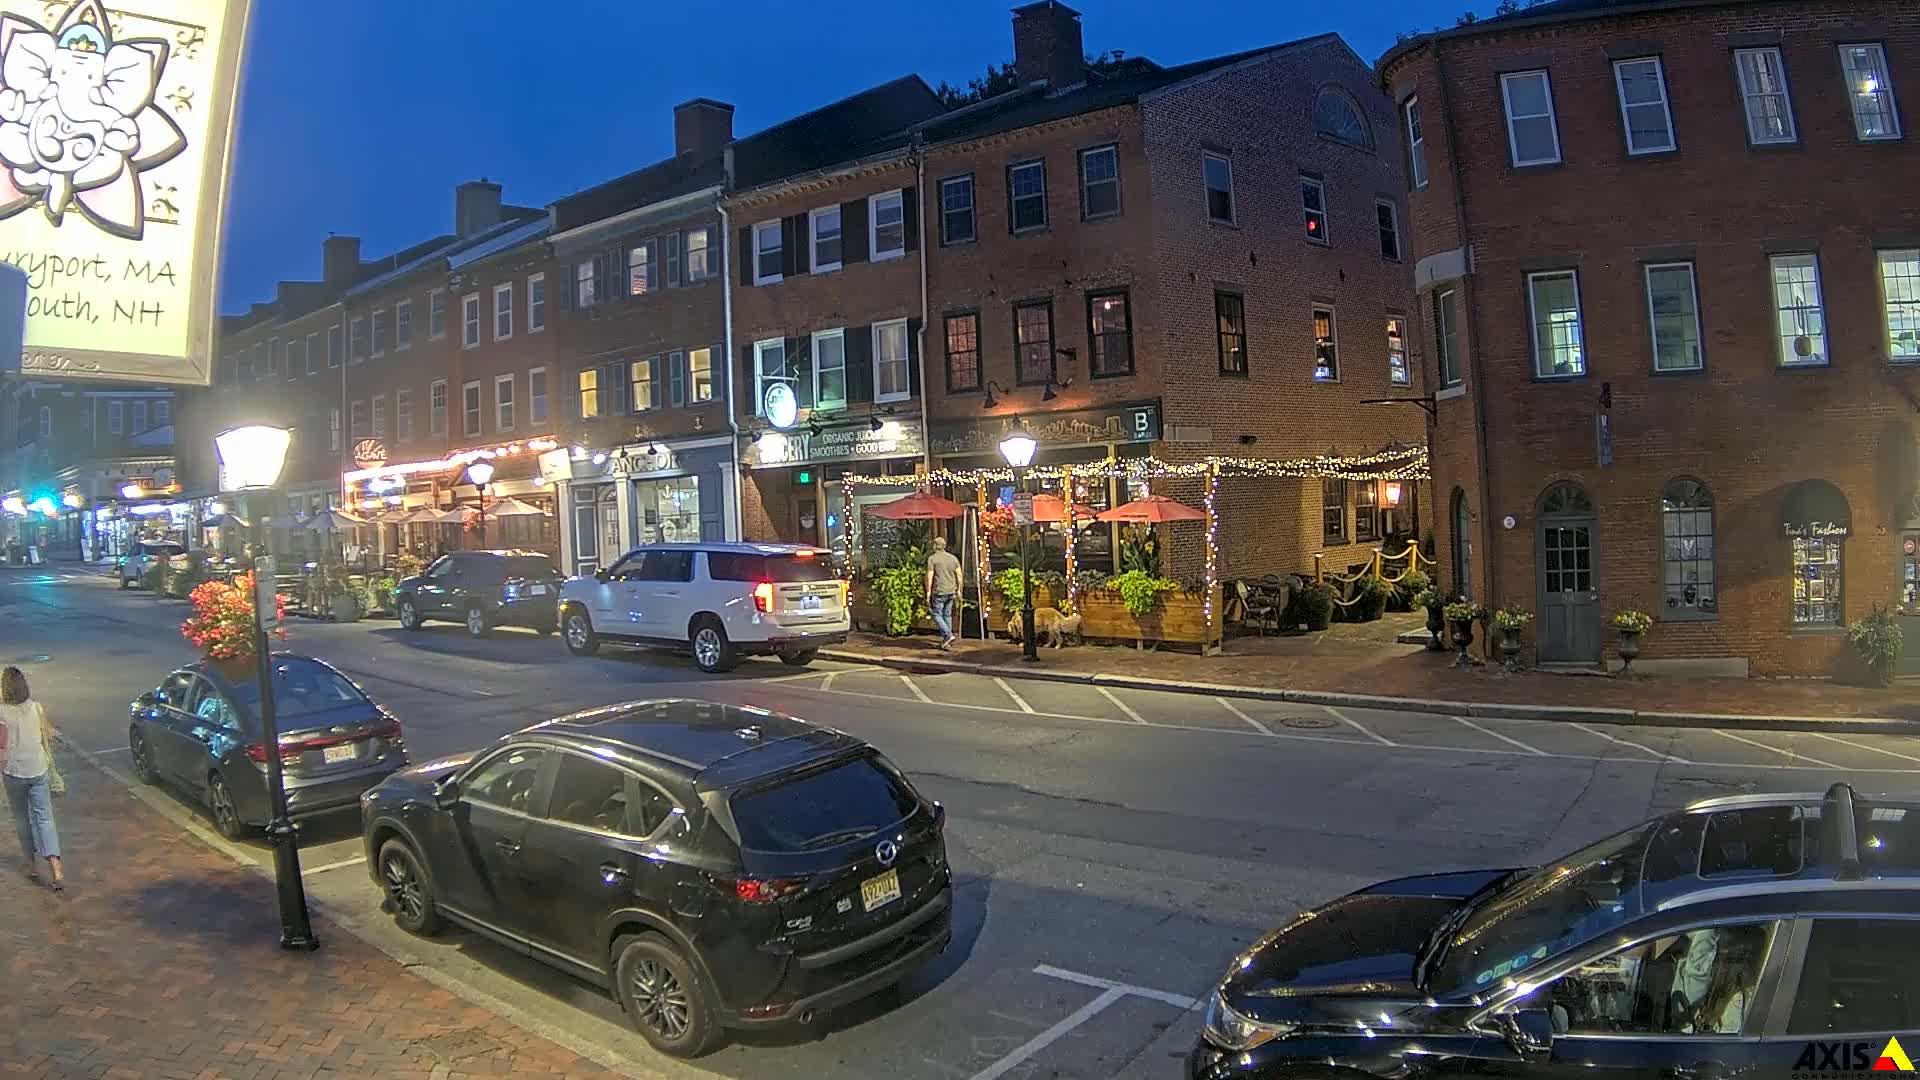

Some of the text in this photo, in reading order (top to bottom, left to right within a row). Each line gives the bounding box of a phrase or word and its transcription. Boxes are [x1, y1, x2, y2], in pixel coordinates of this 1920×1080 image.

[123, 259, 177, 287] MA
[113, 299, 165, 327] NH
[1134, 412, 1149, 432] B
[822, 431, 854, 445] ORGANIC
[759, 433, 810, 464] CERY
[809, 444, 849, 458] SMOOTHIES
[855, 443, 878, 455] GOOD
[1810, 521, 1848, 537] Fashion
